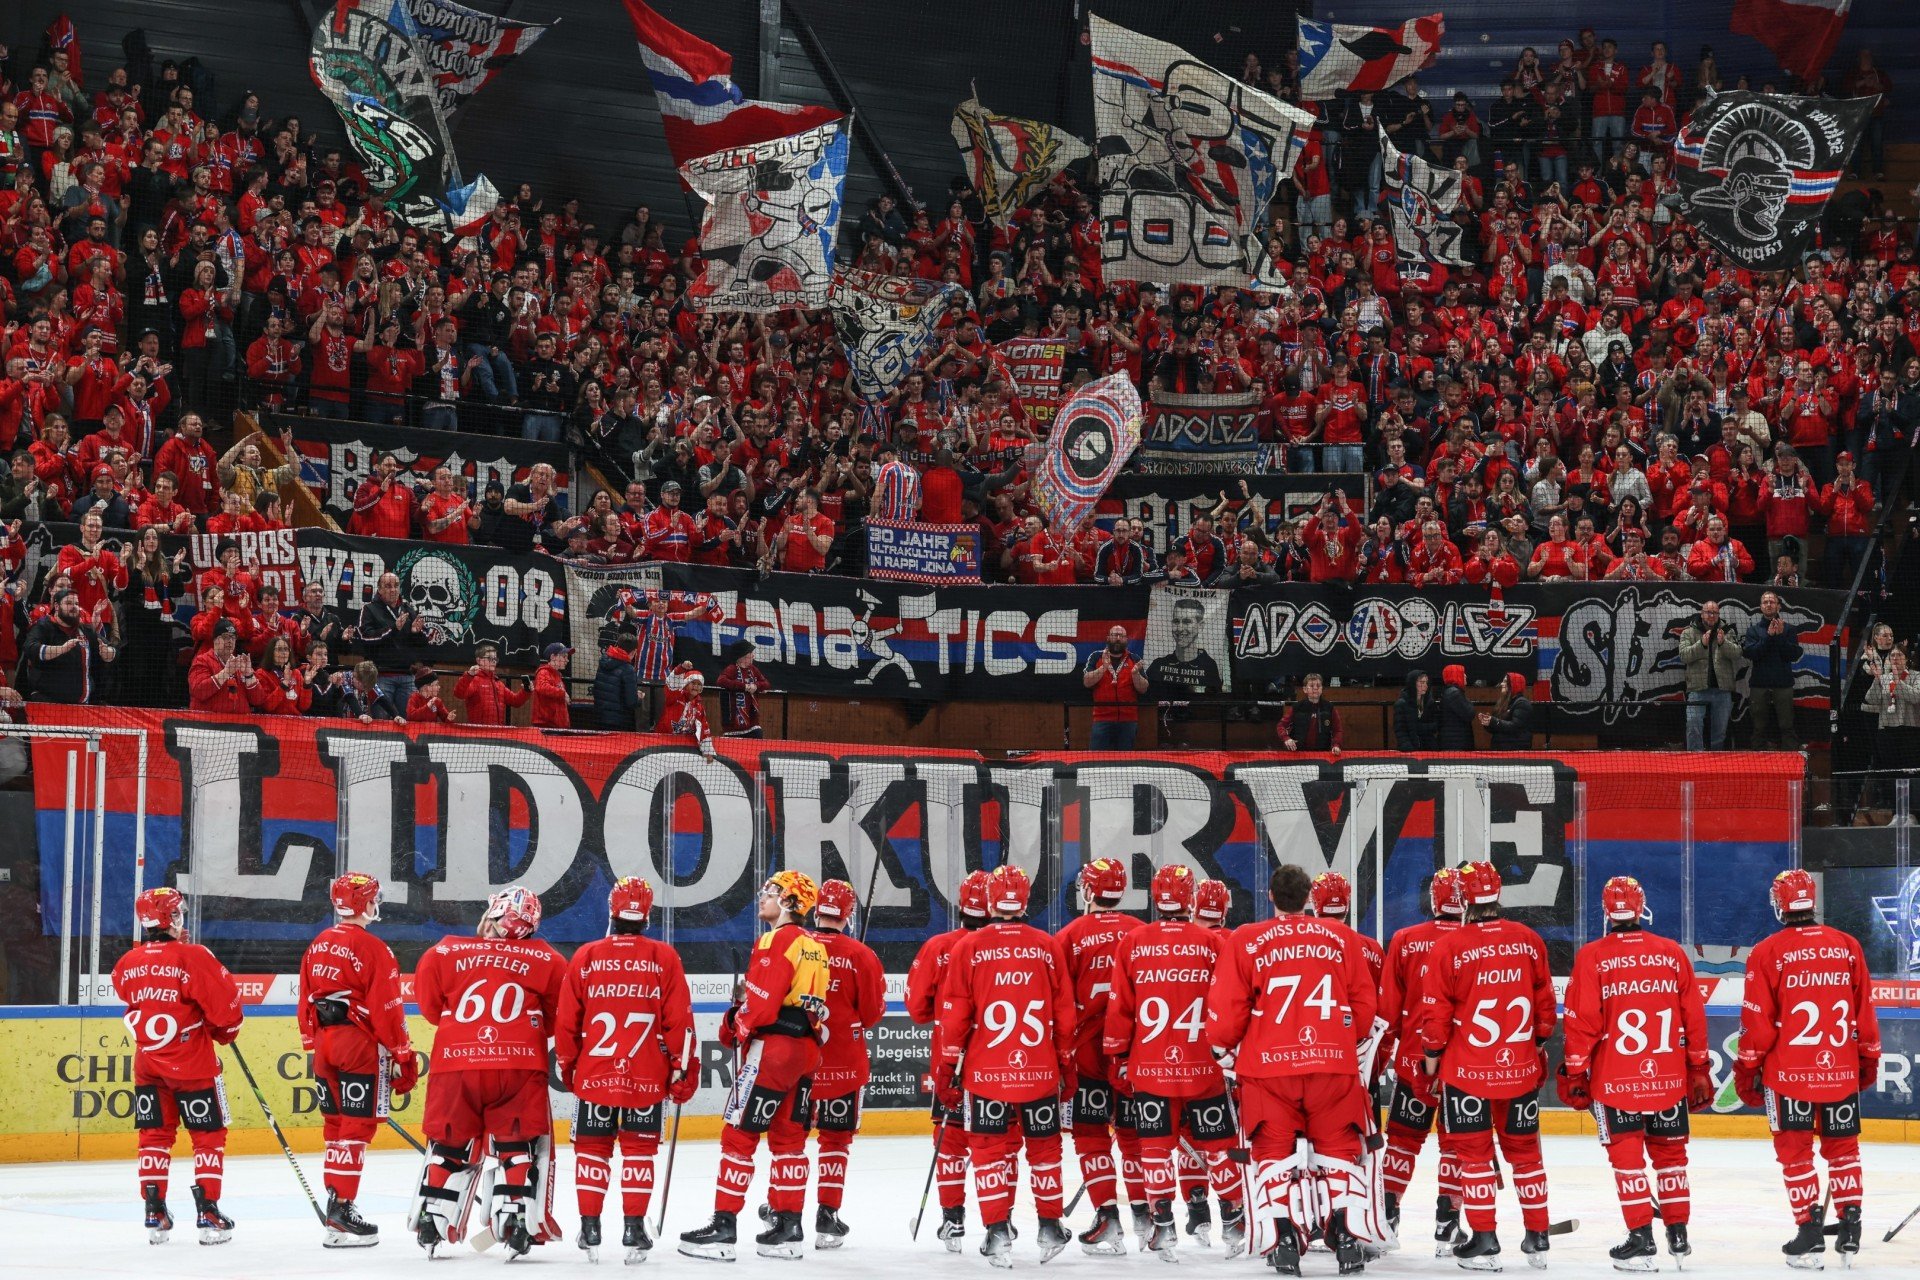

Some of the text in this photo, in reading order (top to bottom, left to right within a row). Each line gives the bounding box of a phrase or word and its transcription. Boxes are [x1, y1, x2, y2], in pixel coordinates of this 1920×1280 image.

[869, 526, 950, 549] 30 JAHR
[869, 542, 948, 560] ULTRAKULTUR
[870, 554, 956, 574] IN RAPPI JONA
[485, 565, 555, 633] 08
[172, 726, 1565, 910] LIDOKURVE
[1257, 924, 1293, 946] SWISS
[452, 942, 552, 961] SWISS CASINOS
[1409, 941, 1435, 954] SWIS
[456, 955, 530, 976] NYFFELER
[1089, 955, 1115, 970] JEN
[995, 971, 1033, 986] MOY
[1136, 968, 1210, 984] ZANGGER
[1477, 968, 1521, 986] HOLM
[1786, 970, 1850, 988] DÜNNER
[691, 980, 730, 995] heizen
[455, 979, 525, 1023] 60
[1266, 974, 1337, 1025] 74
[983, 1000, 1045, 1049] 95
[1139, 996, 1205, 1044] 94
[1467, 996, 1533, 1047] 52
[1789, 999, 1849, 1047] 23
[589, 1011, 656, 1058] 27
[1615, 1007, 1673, 1056] 81
[813, 1070, 857, 1081] KLINIK
[868, 1072, 915, 1082] druckt in
[870, 1085, 915, 1095] Schweiz!
[195, 1153, 221, 1168] OVA
